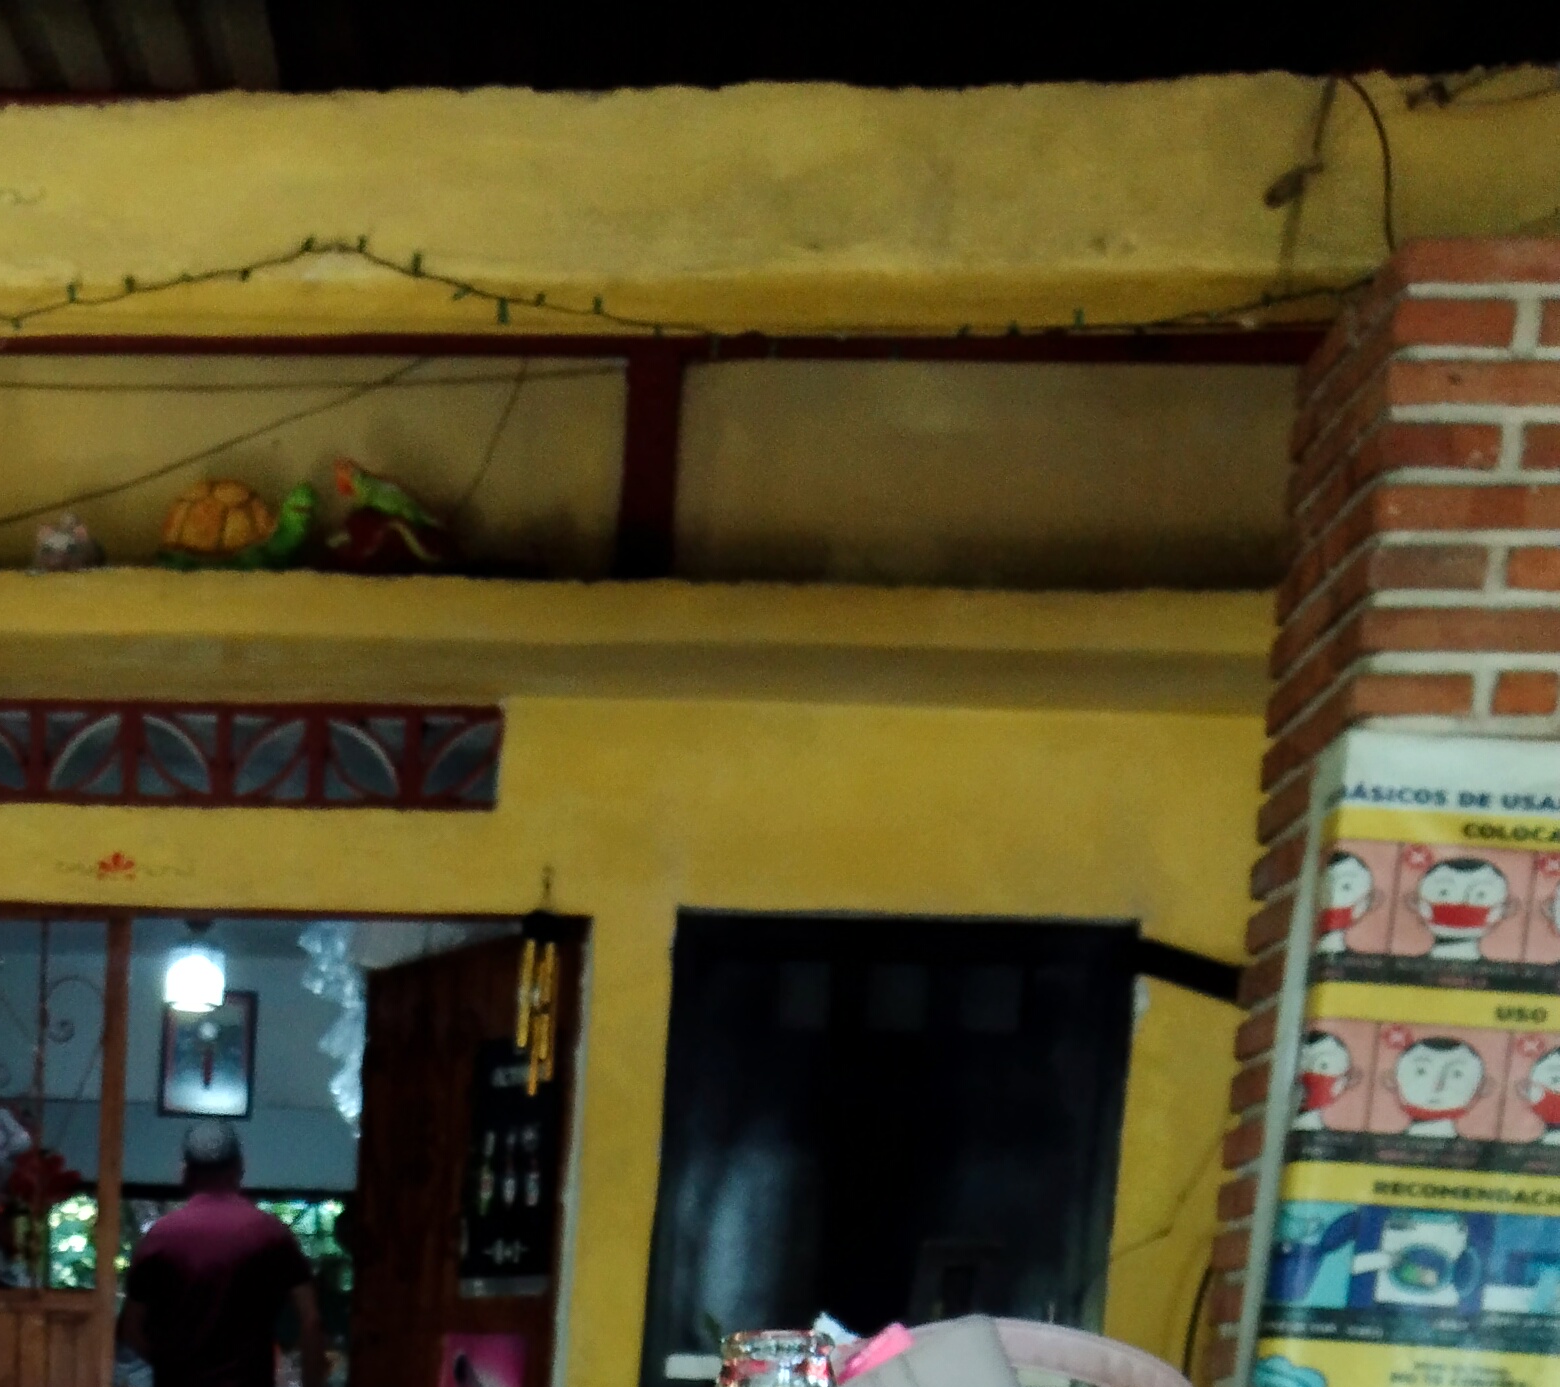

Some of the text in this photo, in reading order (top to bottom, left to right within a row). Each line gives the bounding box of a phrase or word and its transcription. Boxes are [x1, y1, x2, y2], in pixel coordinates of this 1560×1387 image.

[1344, 780, 1560, 812] ÁSICOS DE USA
[1495, 1006, 1547, 1023] USO
